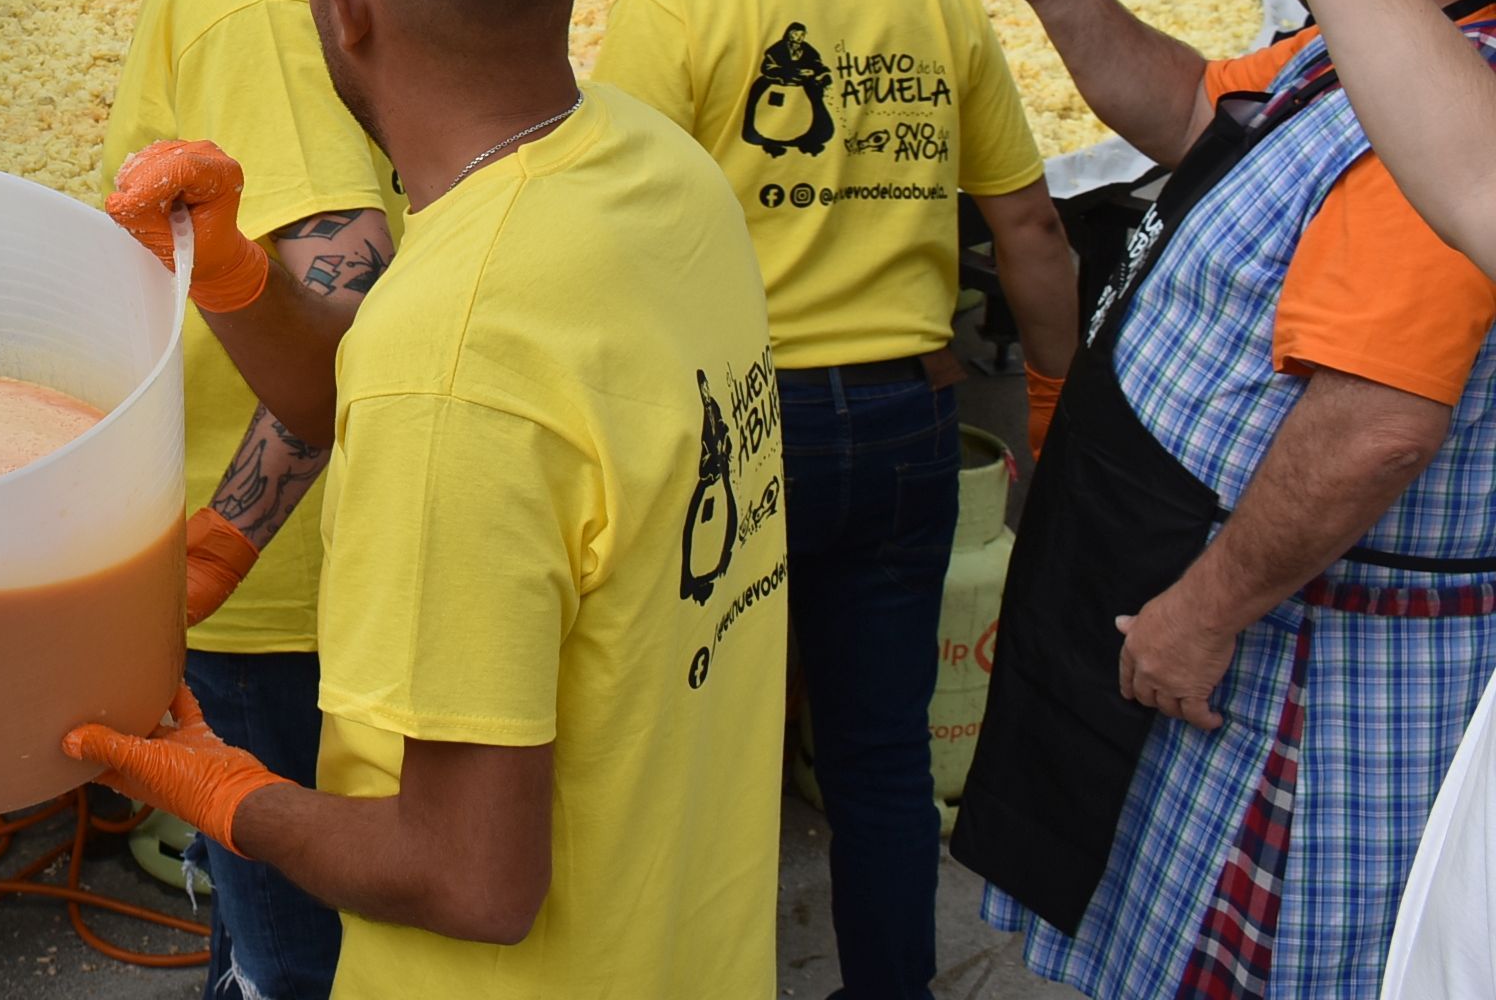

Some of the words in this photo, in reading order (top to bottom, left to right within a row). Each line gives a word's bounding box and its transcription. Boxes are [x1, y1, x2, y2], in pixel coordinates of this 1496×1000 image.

[836, 52, 914, 79] HUEVO
[841, 77, 951, 109] ABUELA
[895, 122, 935, 141] OVO
[894, 139, 949, 163] AVOA
[731, 344, 773, 430] HUEVO
